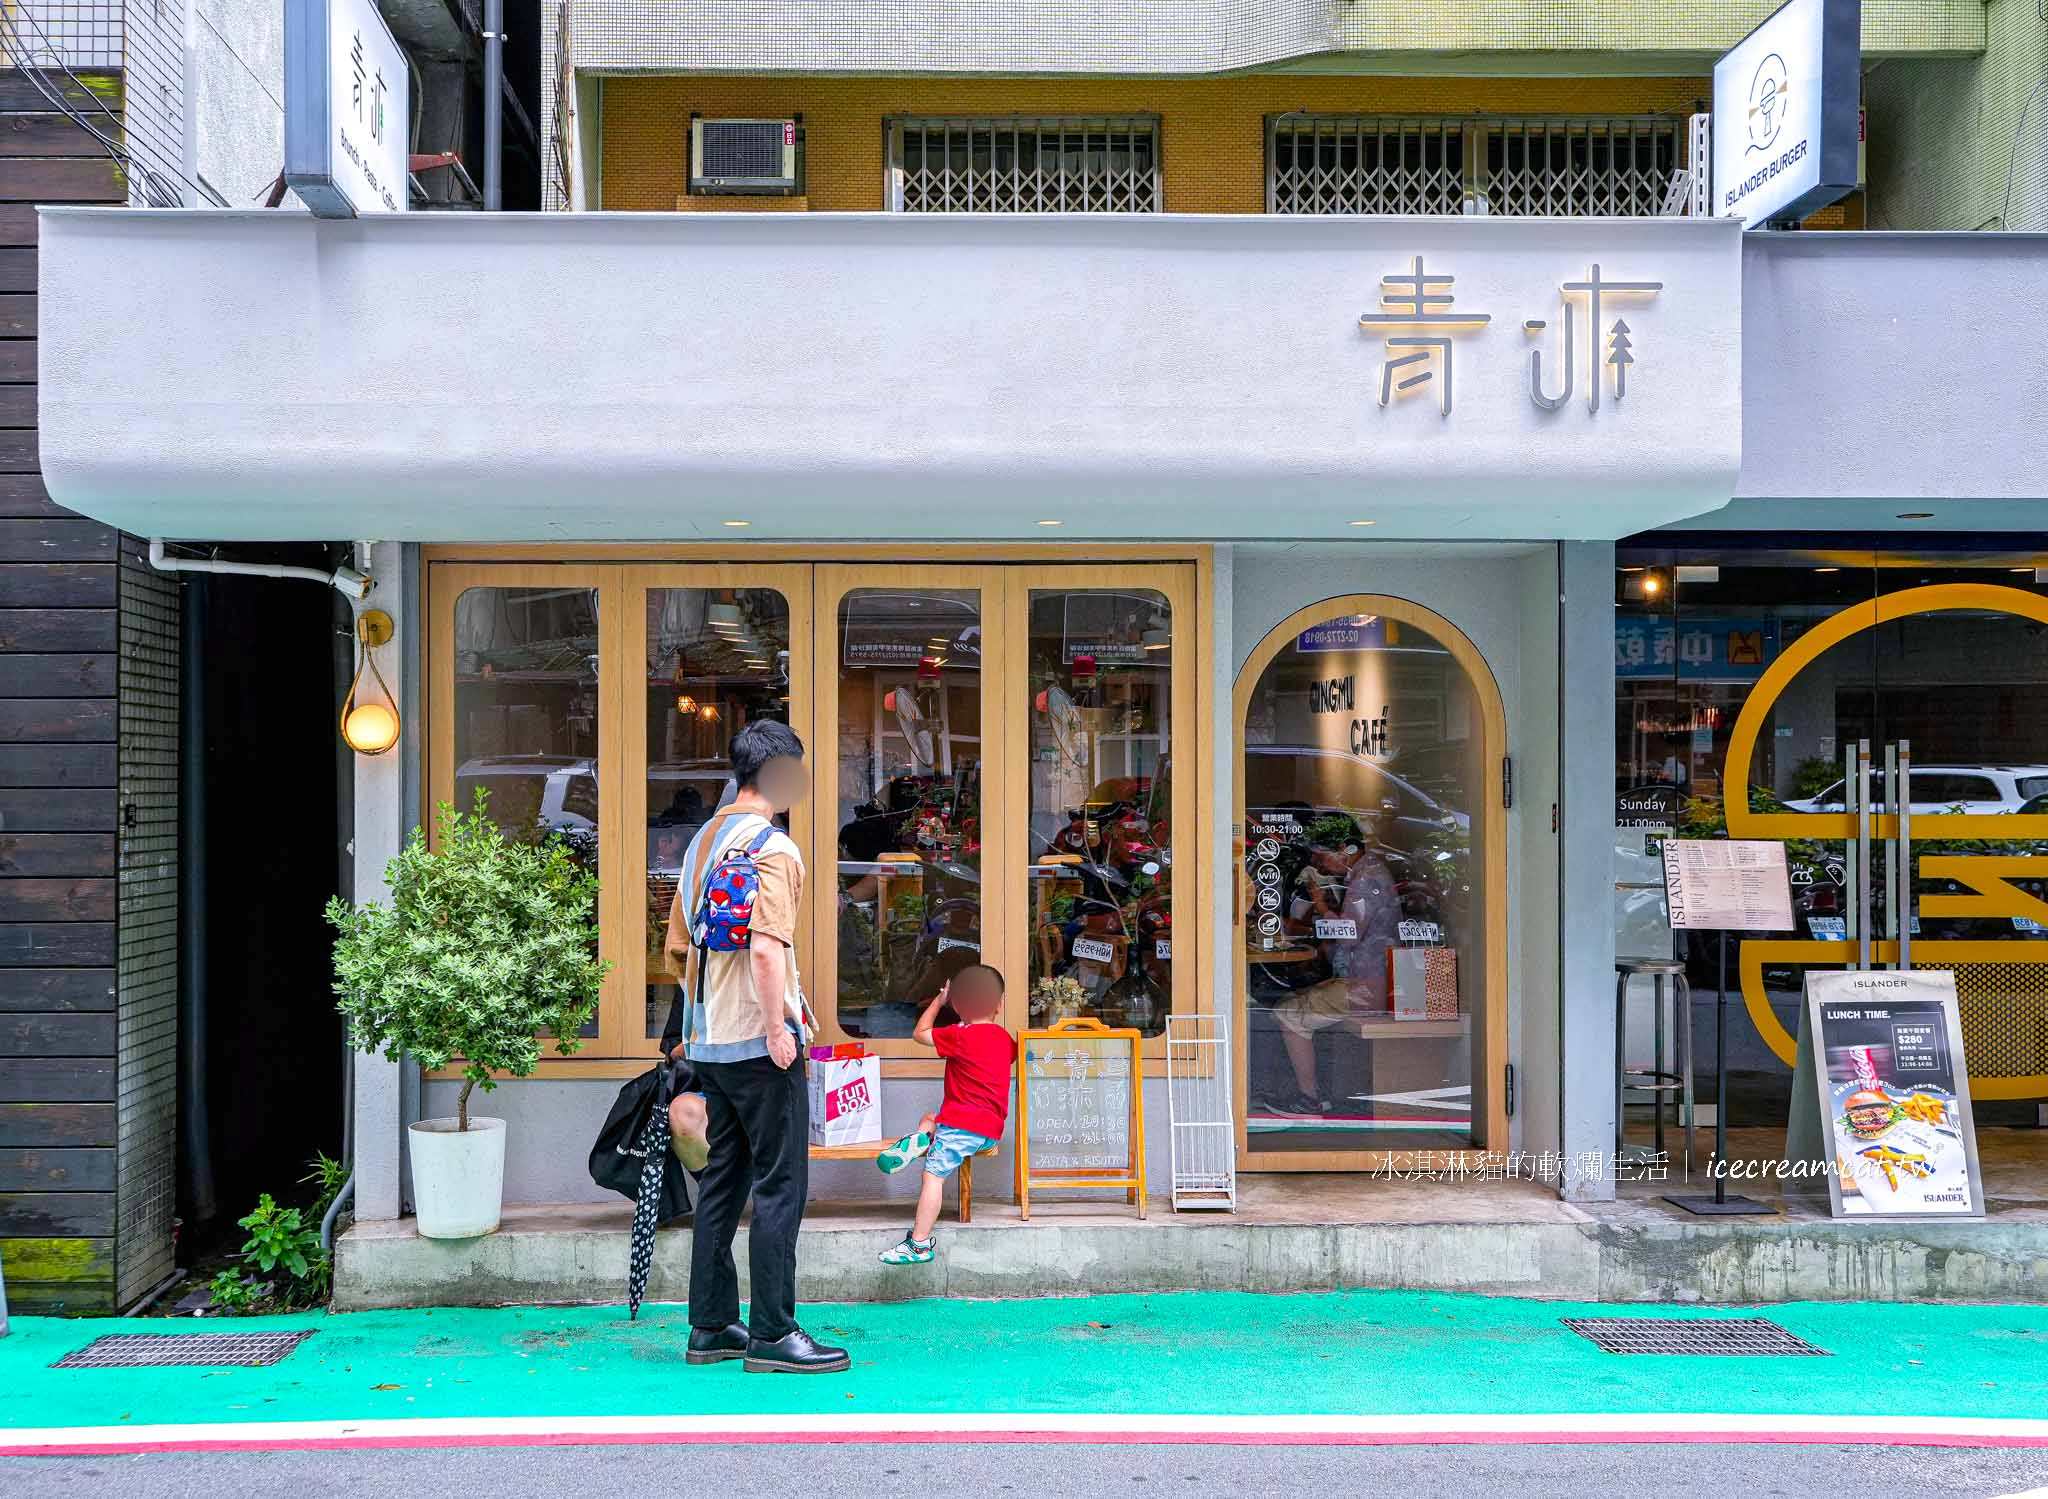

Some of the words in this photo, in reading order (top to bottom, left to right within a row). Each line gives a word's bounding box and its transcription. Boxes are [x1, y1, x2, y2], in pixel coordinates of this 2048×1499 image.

[1725, 168, 1768, 209] ISLANDER
[1769, 139, 1808, 179] BURGER
[1620, 798, 1666, 812] Sunday
[1251, 825, 1303, 834] 10:30-21:00
[1665, 841, 1686, 927] ISLANDER
[1853, 980, 1908, 988] ISLANDER
[1827, 1010, 1861, 1020] LUNCH
[1865, 1010, 1891, 1020] TIME.
[1897, 1035, 1923, 1045] $280
[837, 1082, 866, 1105] fun
[836, 1093, 870, 1116] box
[1923, 1193, 1964, 1203] ISLANDER
